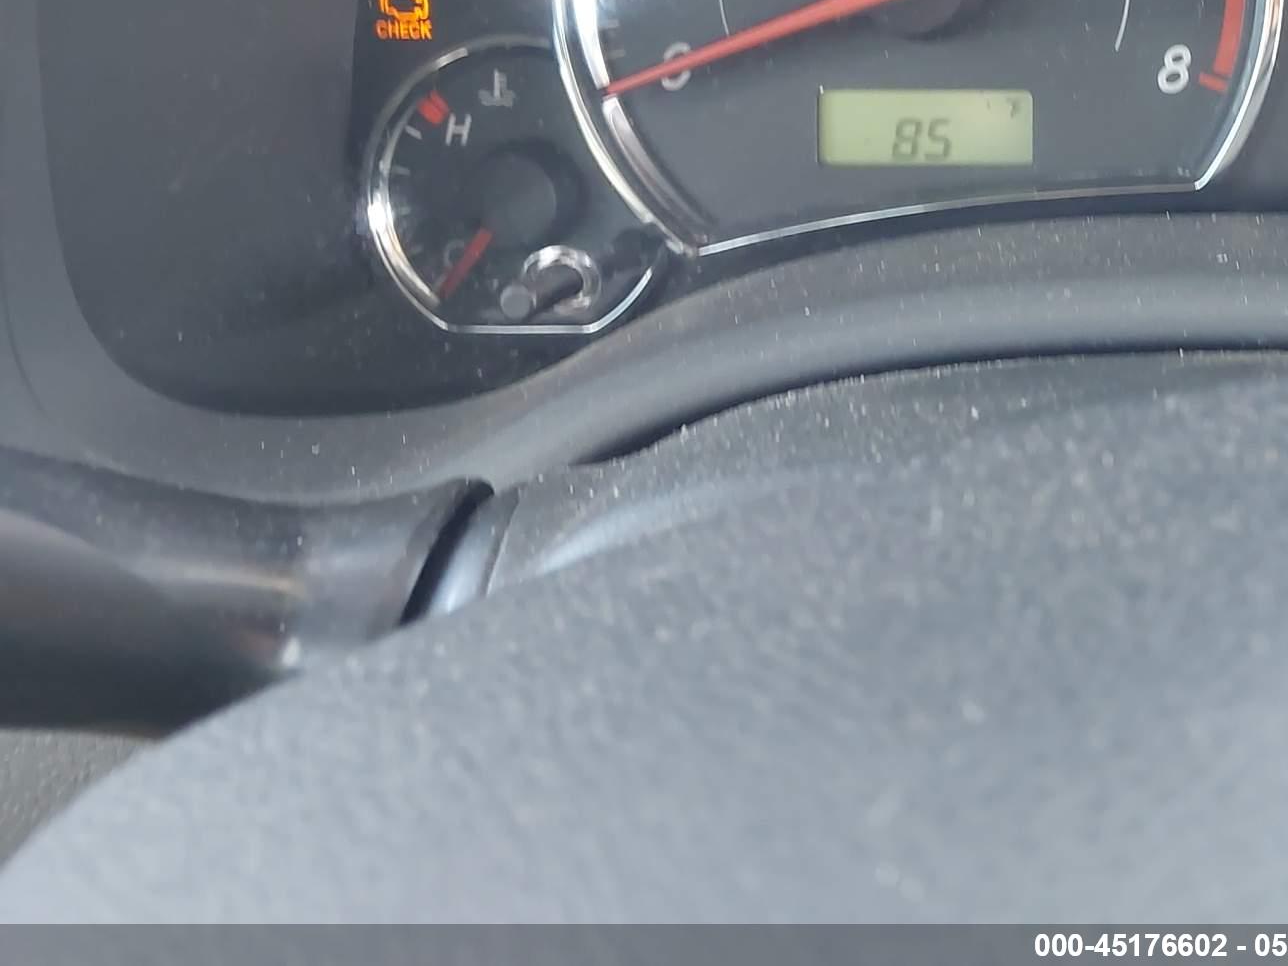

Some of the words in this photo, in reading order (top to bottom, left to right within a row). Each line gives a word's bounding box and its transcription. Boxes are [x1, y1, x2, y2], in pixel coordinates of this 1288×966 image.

[376, 19, 433, 40] CHECK
[1157, 44, 1192, 94] 8
[444, 113, 472, 146] H
[892, 117, 953, 162] 85
